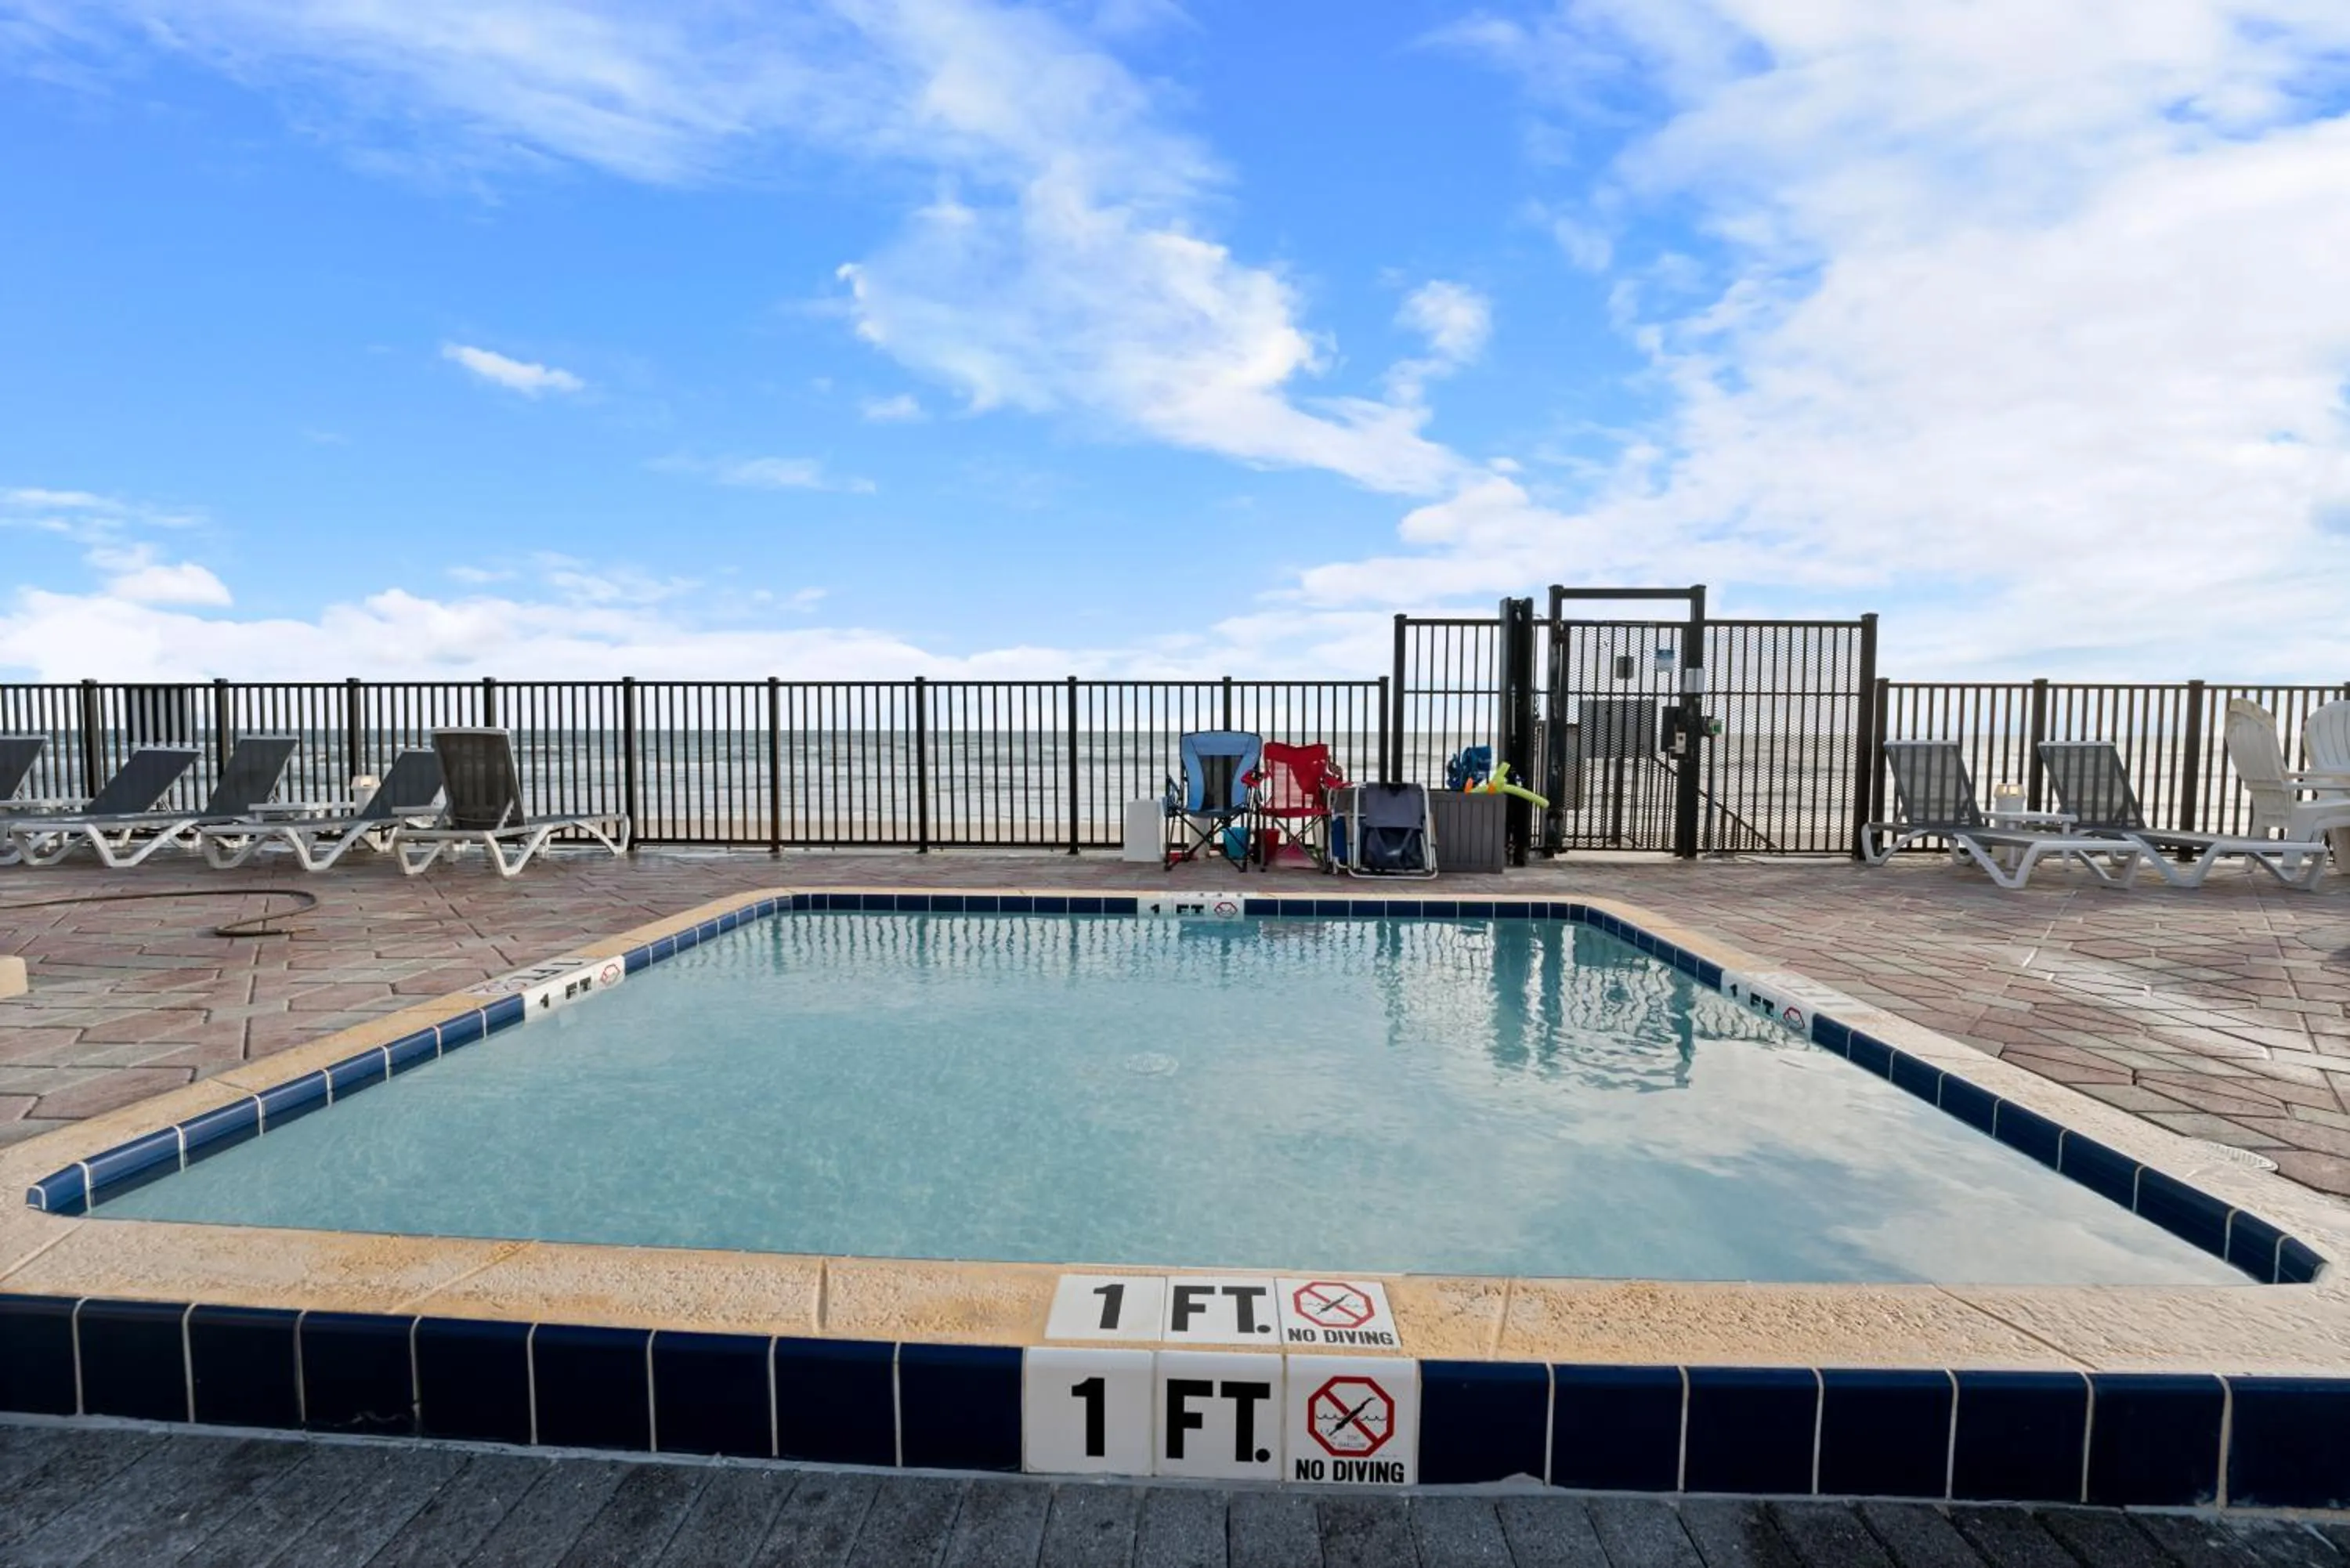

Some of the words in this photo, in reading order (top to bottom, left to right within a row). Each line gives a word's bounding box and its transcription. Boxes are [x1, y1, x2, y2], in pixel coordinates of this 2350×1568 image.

[1093, 1284, 1124, 1329] 1
[1171, 1285, 1271, 1334] FT.
[1288, 1328, 1317, 1343] NO
[1322, 1329, 1394, 1346] DIVING
[1071, 1377, 1105, 1458] 1
[1166, 1378, 1271, 1463] FT.
[1295, 1458, 1325, 1481] NO
[1332, 1459, 1405, 1484] DIVING
